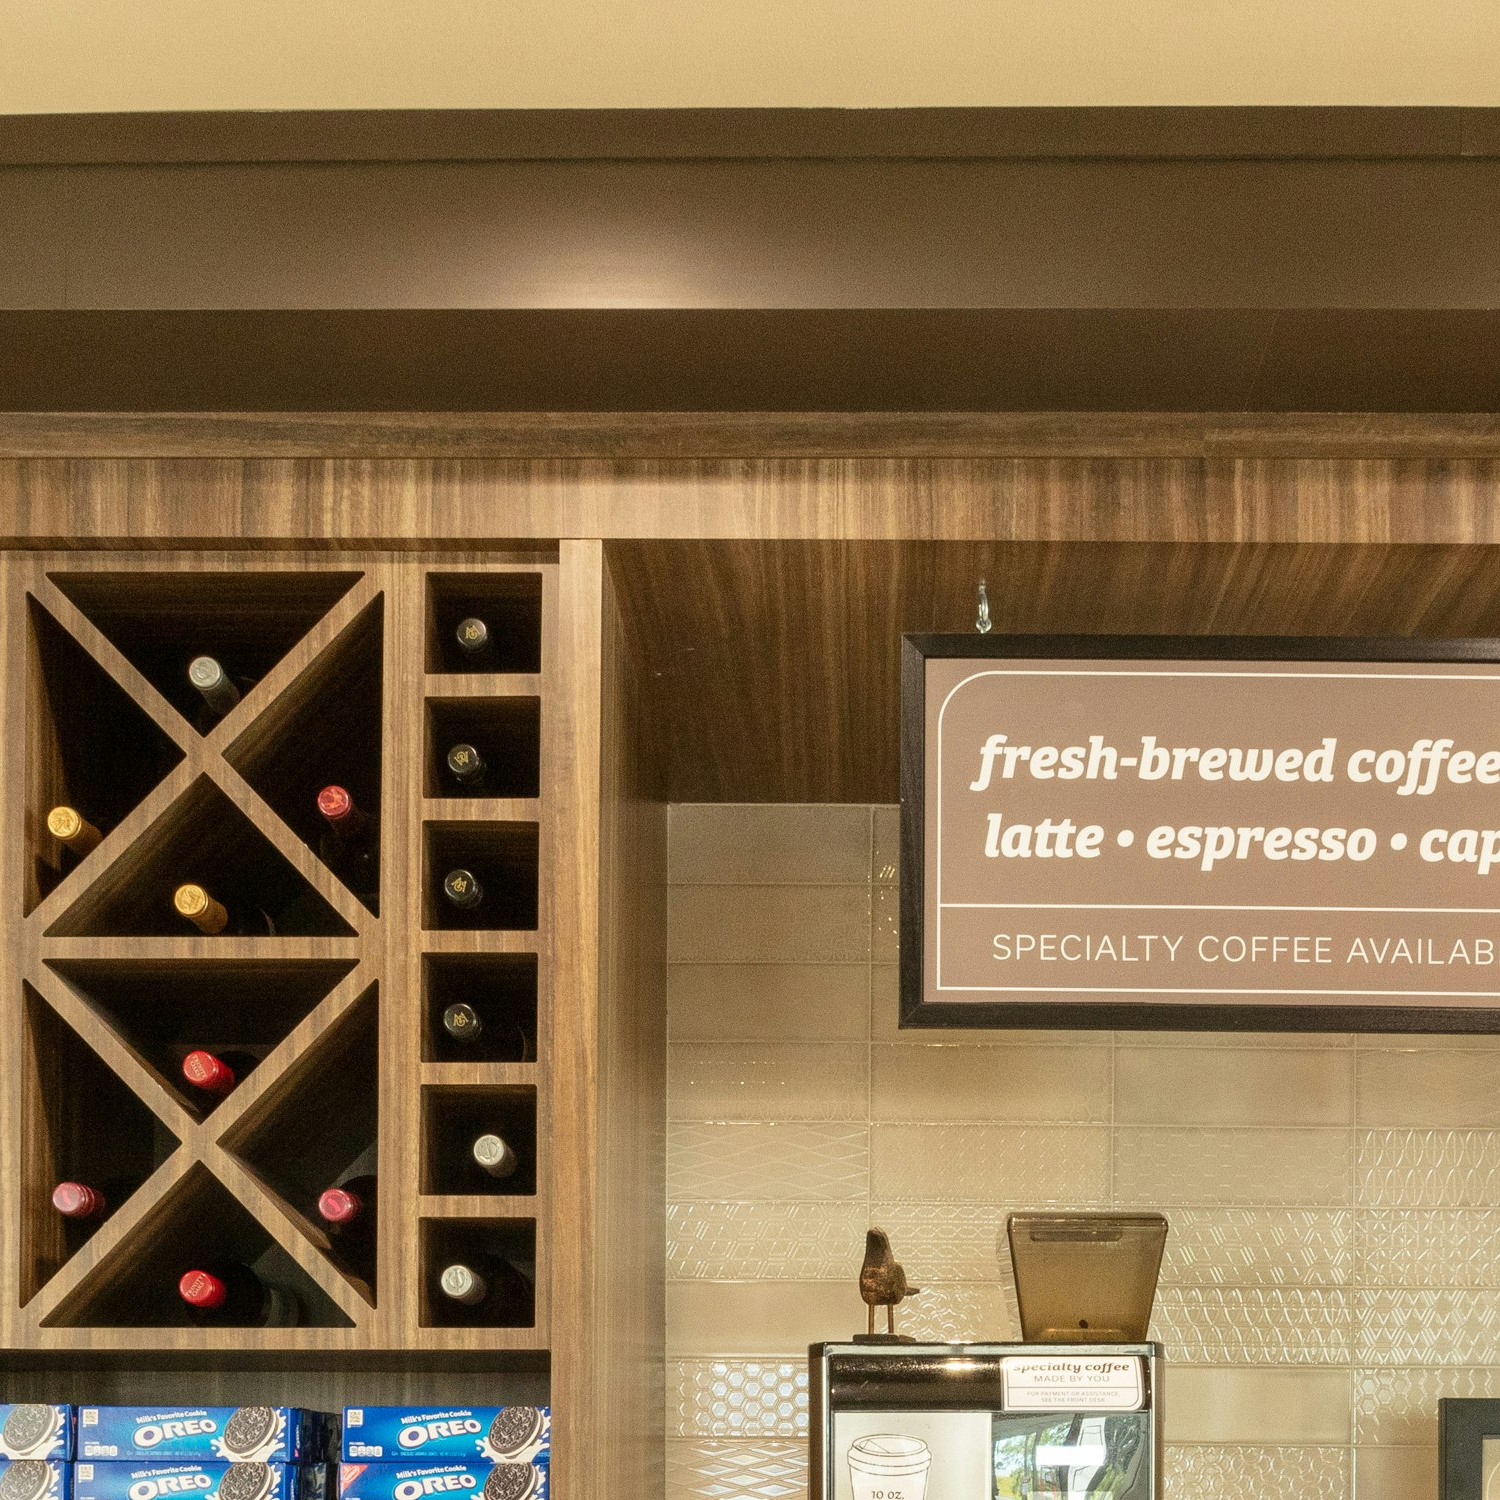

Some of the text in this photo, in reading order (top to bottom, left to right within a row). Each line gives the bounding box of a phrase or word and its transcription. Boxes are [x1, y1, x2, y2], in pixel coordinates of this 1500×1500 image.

[970, 735, 1336, 791] fresh-brewed
[984, 814, 1103, 858] latte
[1147, 825, 1377, 870] espresso
[992, 934, 1183, 962] SPECIALTY
[1199, 936, 1332, 964] COFFEE
[1085, 1363, 1129, 1373] coffee
[157, 1412, 183, 1421] Favorite
[133, 1418, 217, 1448] OREO
[397, 1419, 482, 1449] OREO
[417, 1468, 443, 1477] Favorite
[871, 1490, 904, 1500] 10 oz.
